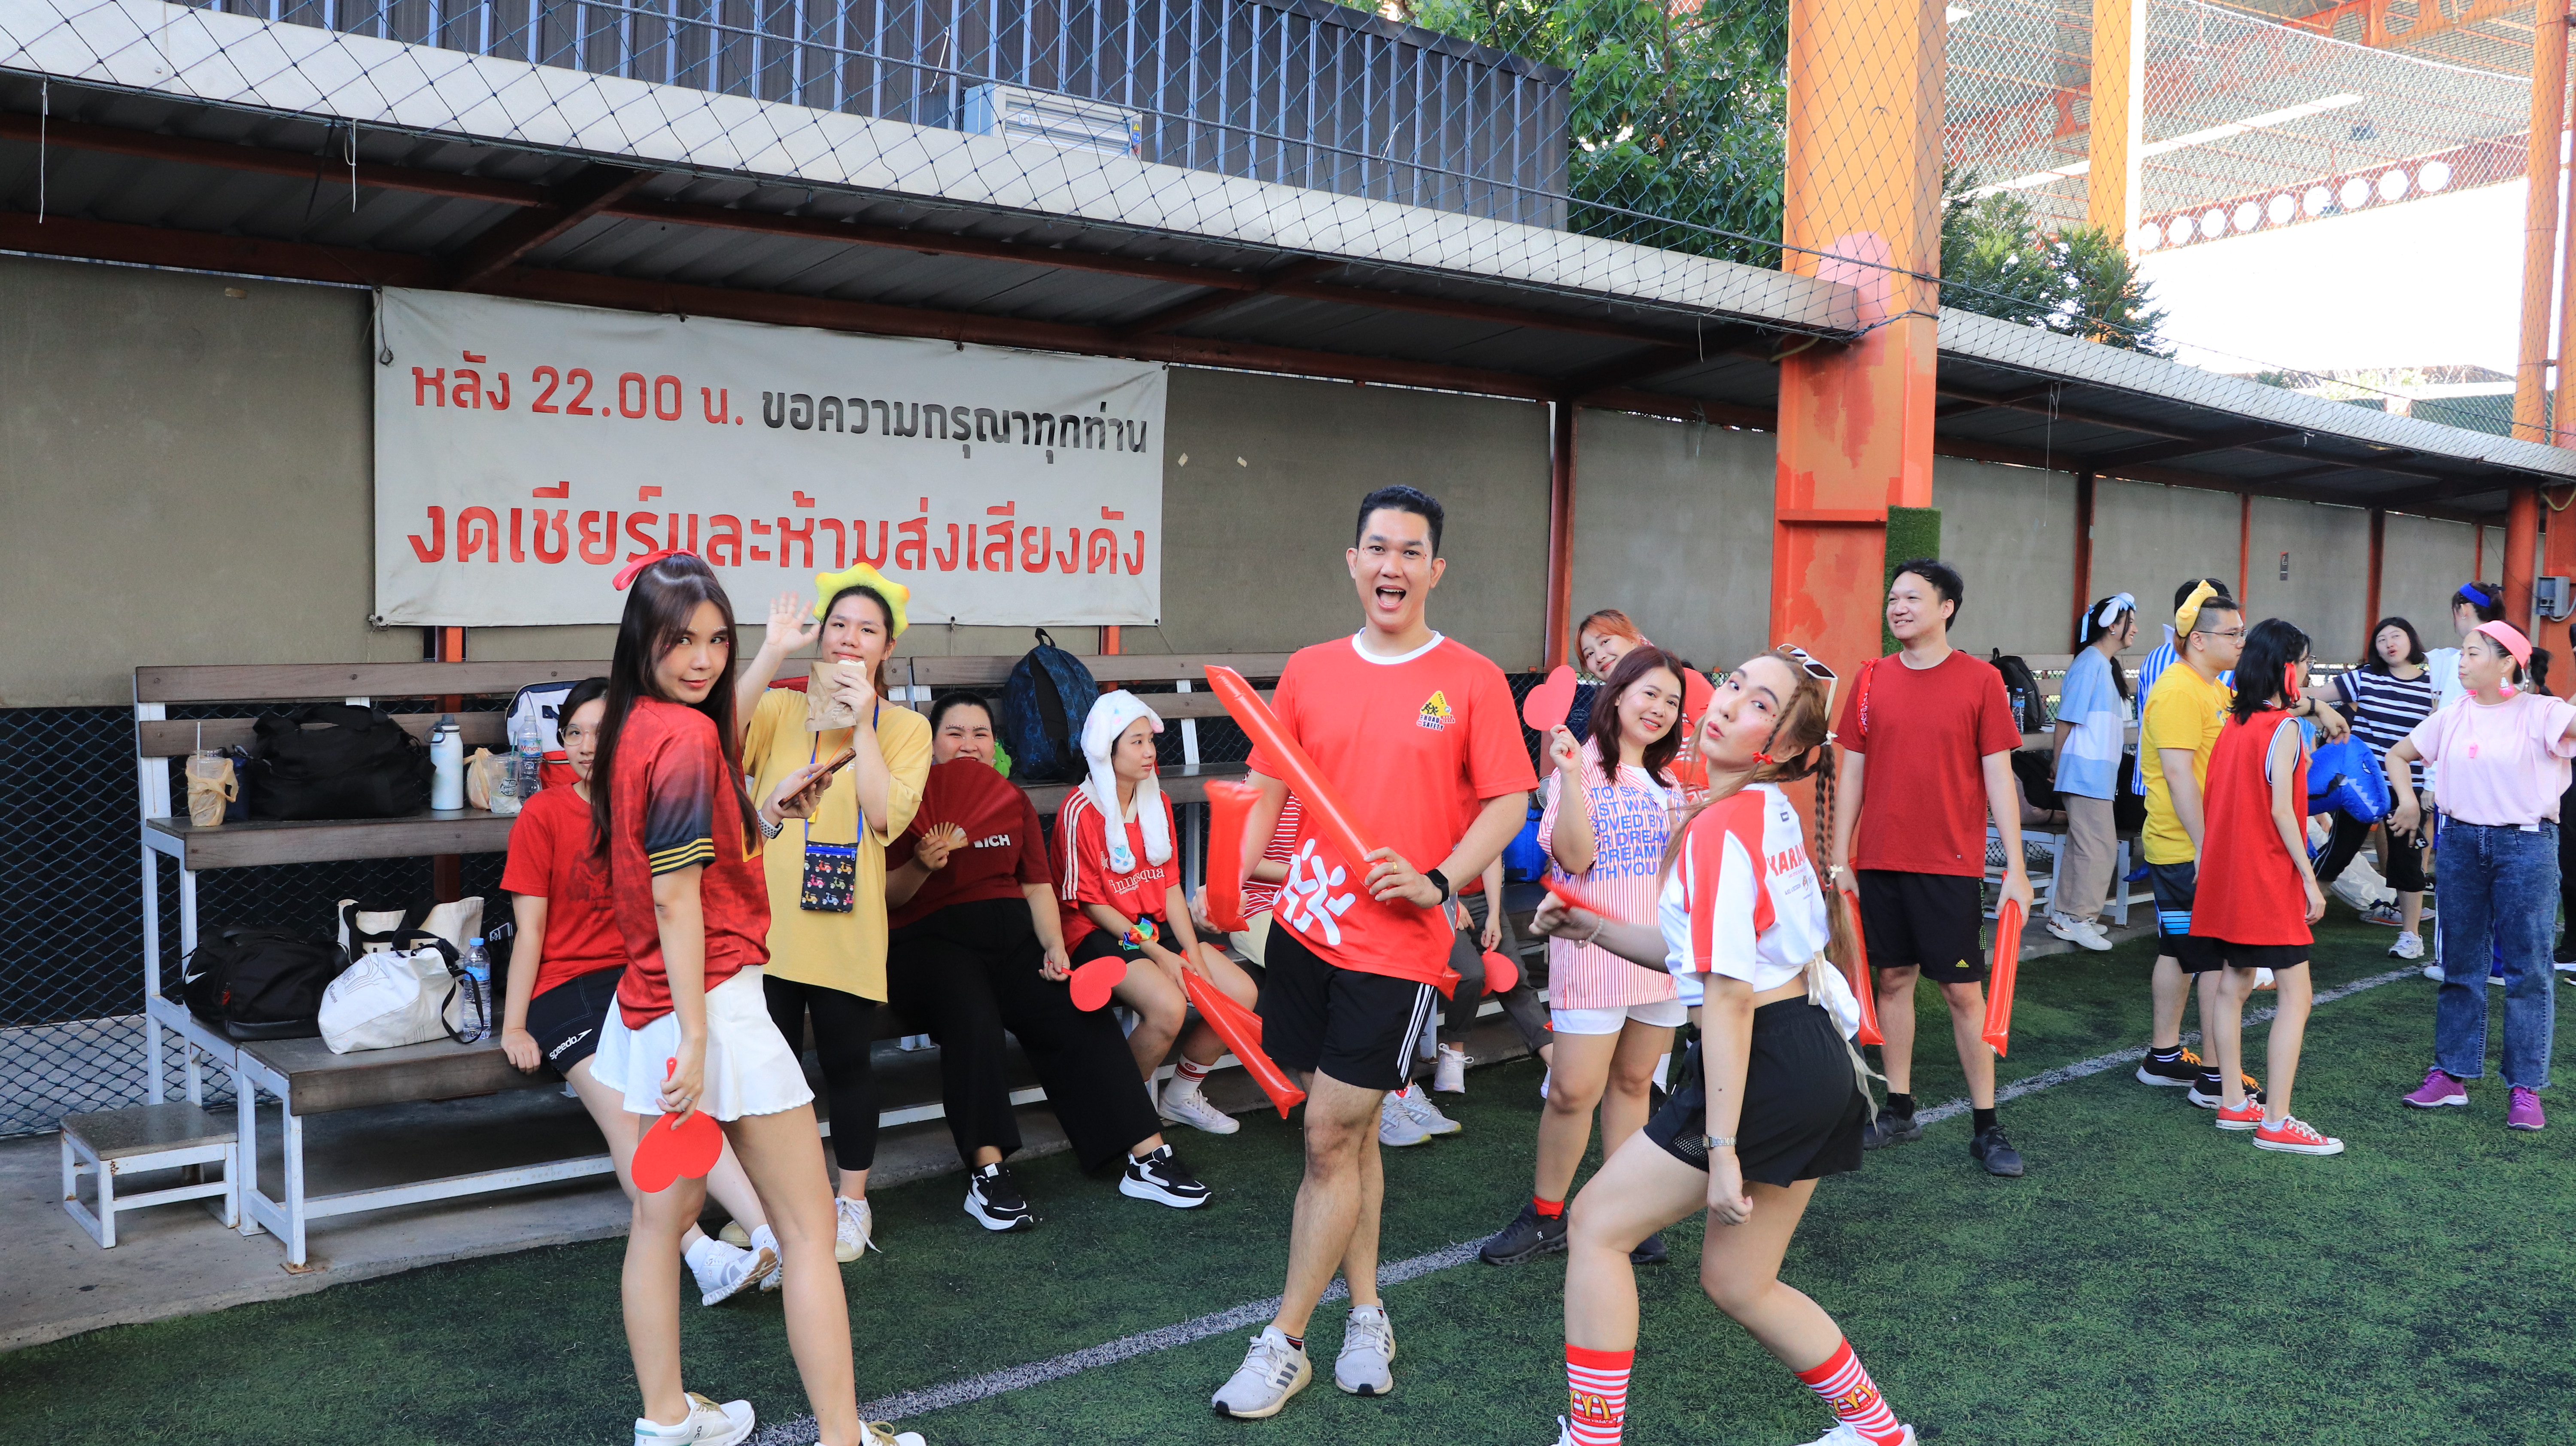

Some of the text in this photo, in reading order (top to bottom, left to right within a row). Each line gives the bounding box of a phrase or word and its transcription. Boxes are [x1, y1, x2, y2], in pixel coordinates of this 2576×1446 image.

[412, 350, 1148, 465] หลัง 22.00 น. ขอความกรุณาทุกท่าน
[1422, 721, 1443, 731] SAFETY
[1424, 715, 1440, 723] ROAD
[1597, 814, 1643, 832] OVED
[1598, 845, 1656, 865] DREAM
[1620, 861, 1657, 878] YOU
[549, 1036, 577, 1060] speedo
